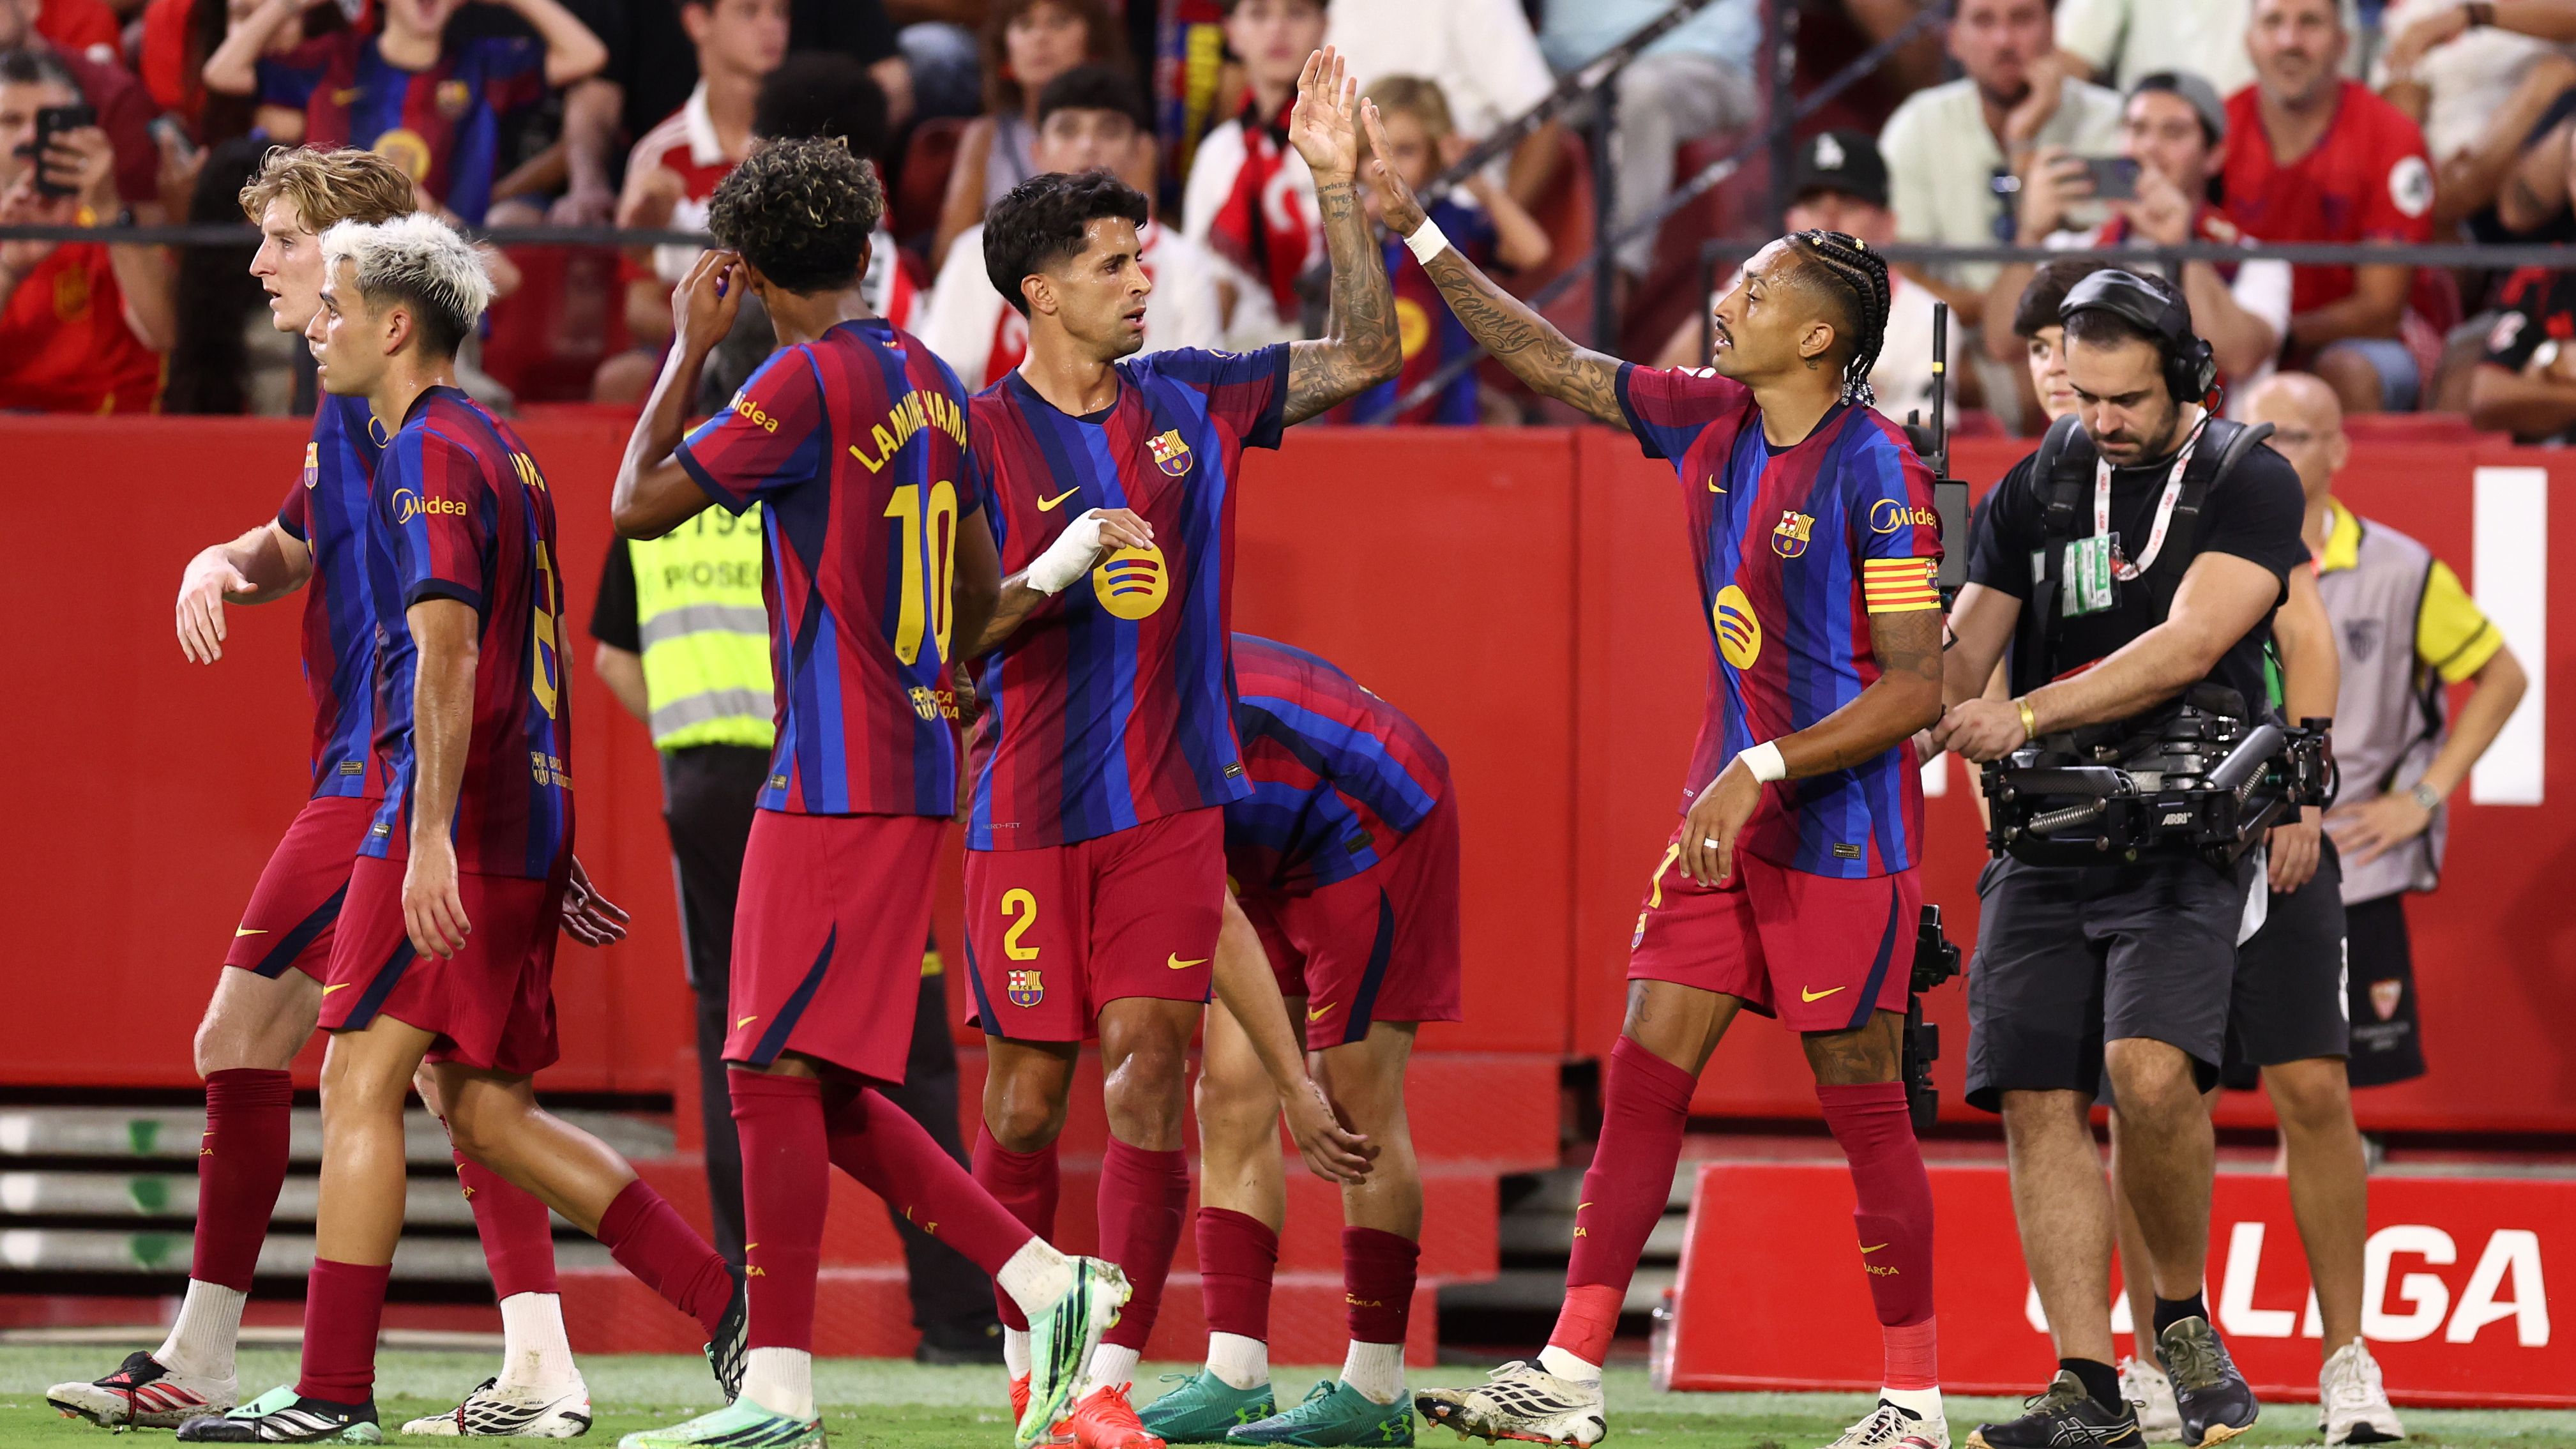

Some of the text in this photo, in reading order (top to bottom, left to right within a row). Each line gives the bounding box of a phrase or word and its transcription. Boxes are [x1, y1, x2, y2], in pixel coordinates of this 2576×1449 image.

[848, 390, 929, 474] LAMINE
[392, 488, 467, 524] Midea
[883, 480, 958, 666] 10
[2161, 812, 2188, 826] ARRI
[1001, 888, 1040, 960] 2
